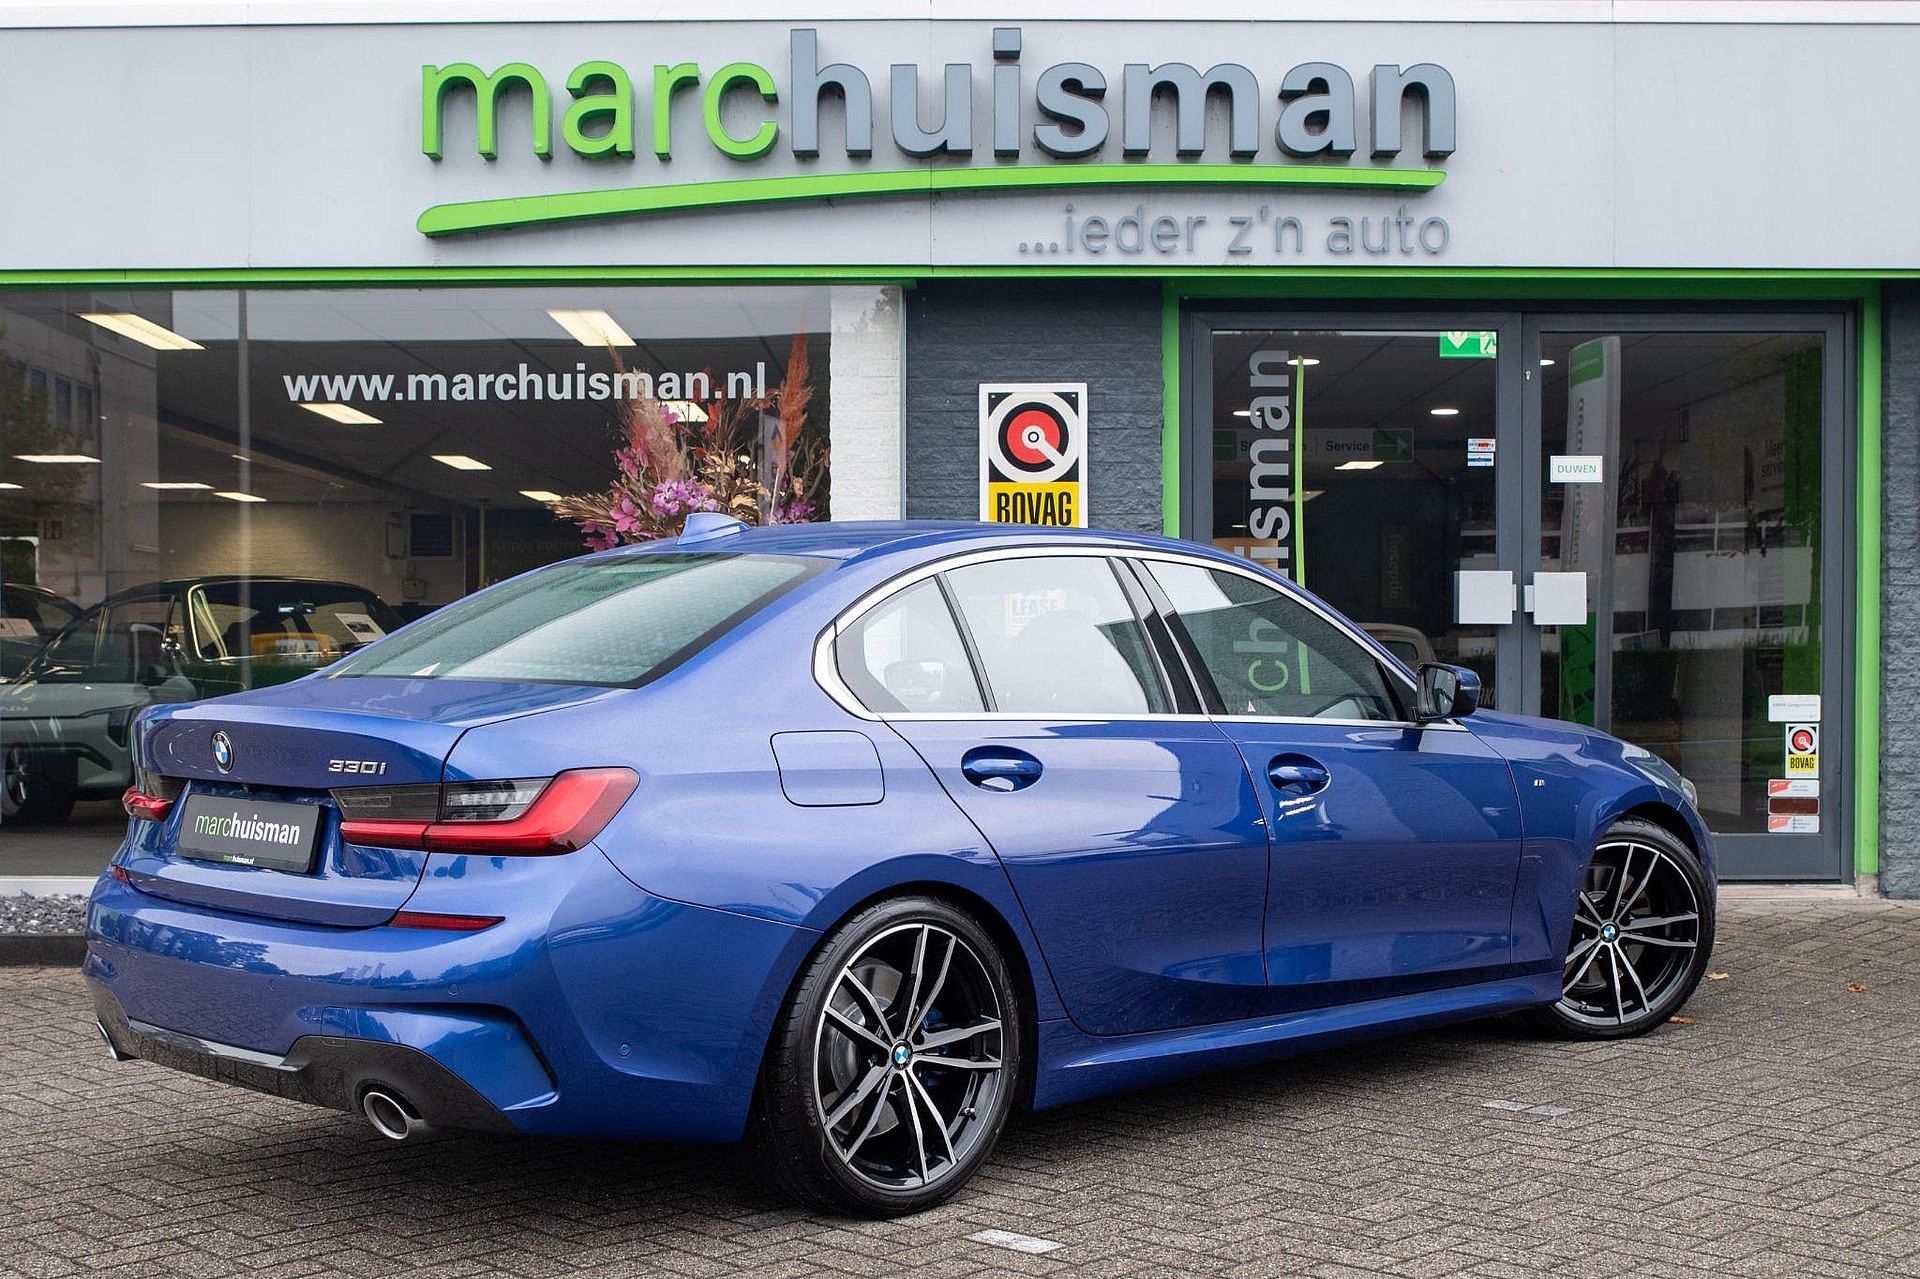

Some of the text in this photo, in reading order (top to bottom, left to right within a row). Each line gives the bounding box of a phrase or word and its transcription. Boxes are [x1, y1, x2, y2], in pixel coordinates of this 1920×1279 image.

[421, 27, 1457, 161] marchuisman
[1018, 203, 1450, 254] ...ieder z'n auto
[284, 362, 766, 401] www.marchuisman.nl
[1557, 464, 1597, 474] DUWEN
[996, 491, 1072, 526] BOVAG
[329, 759, 387, 775] 330i
[1790, 757, 1815, 769] BOVAG
[194, 811, 300, 845] marchuisman
